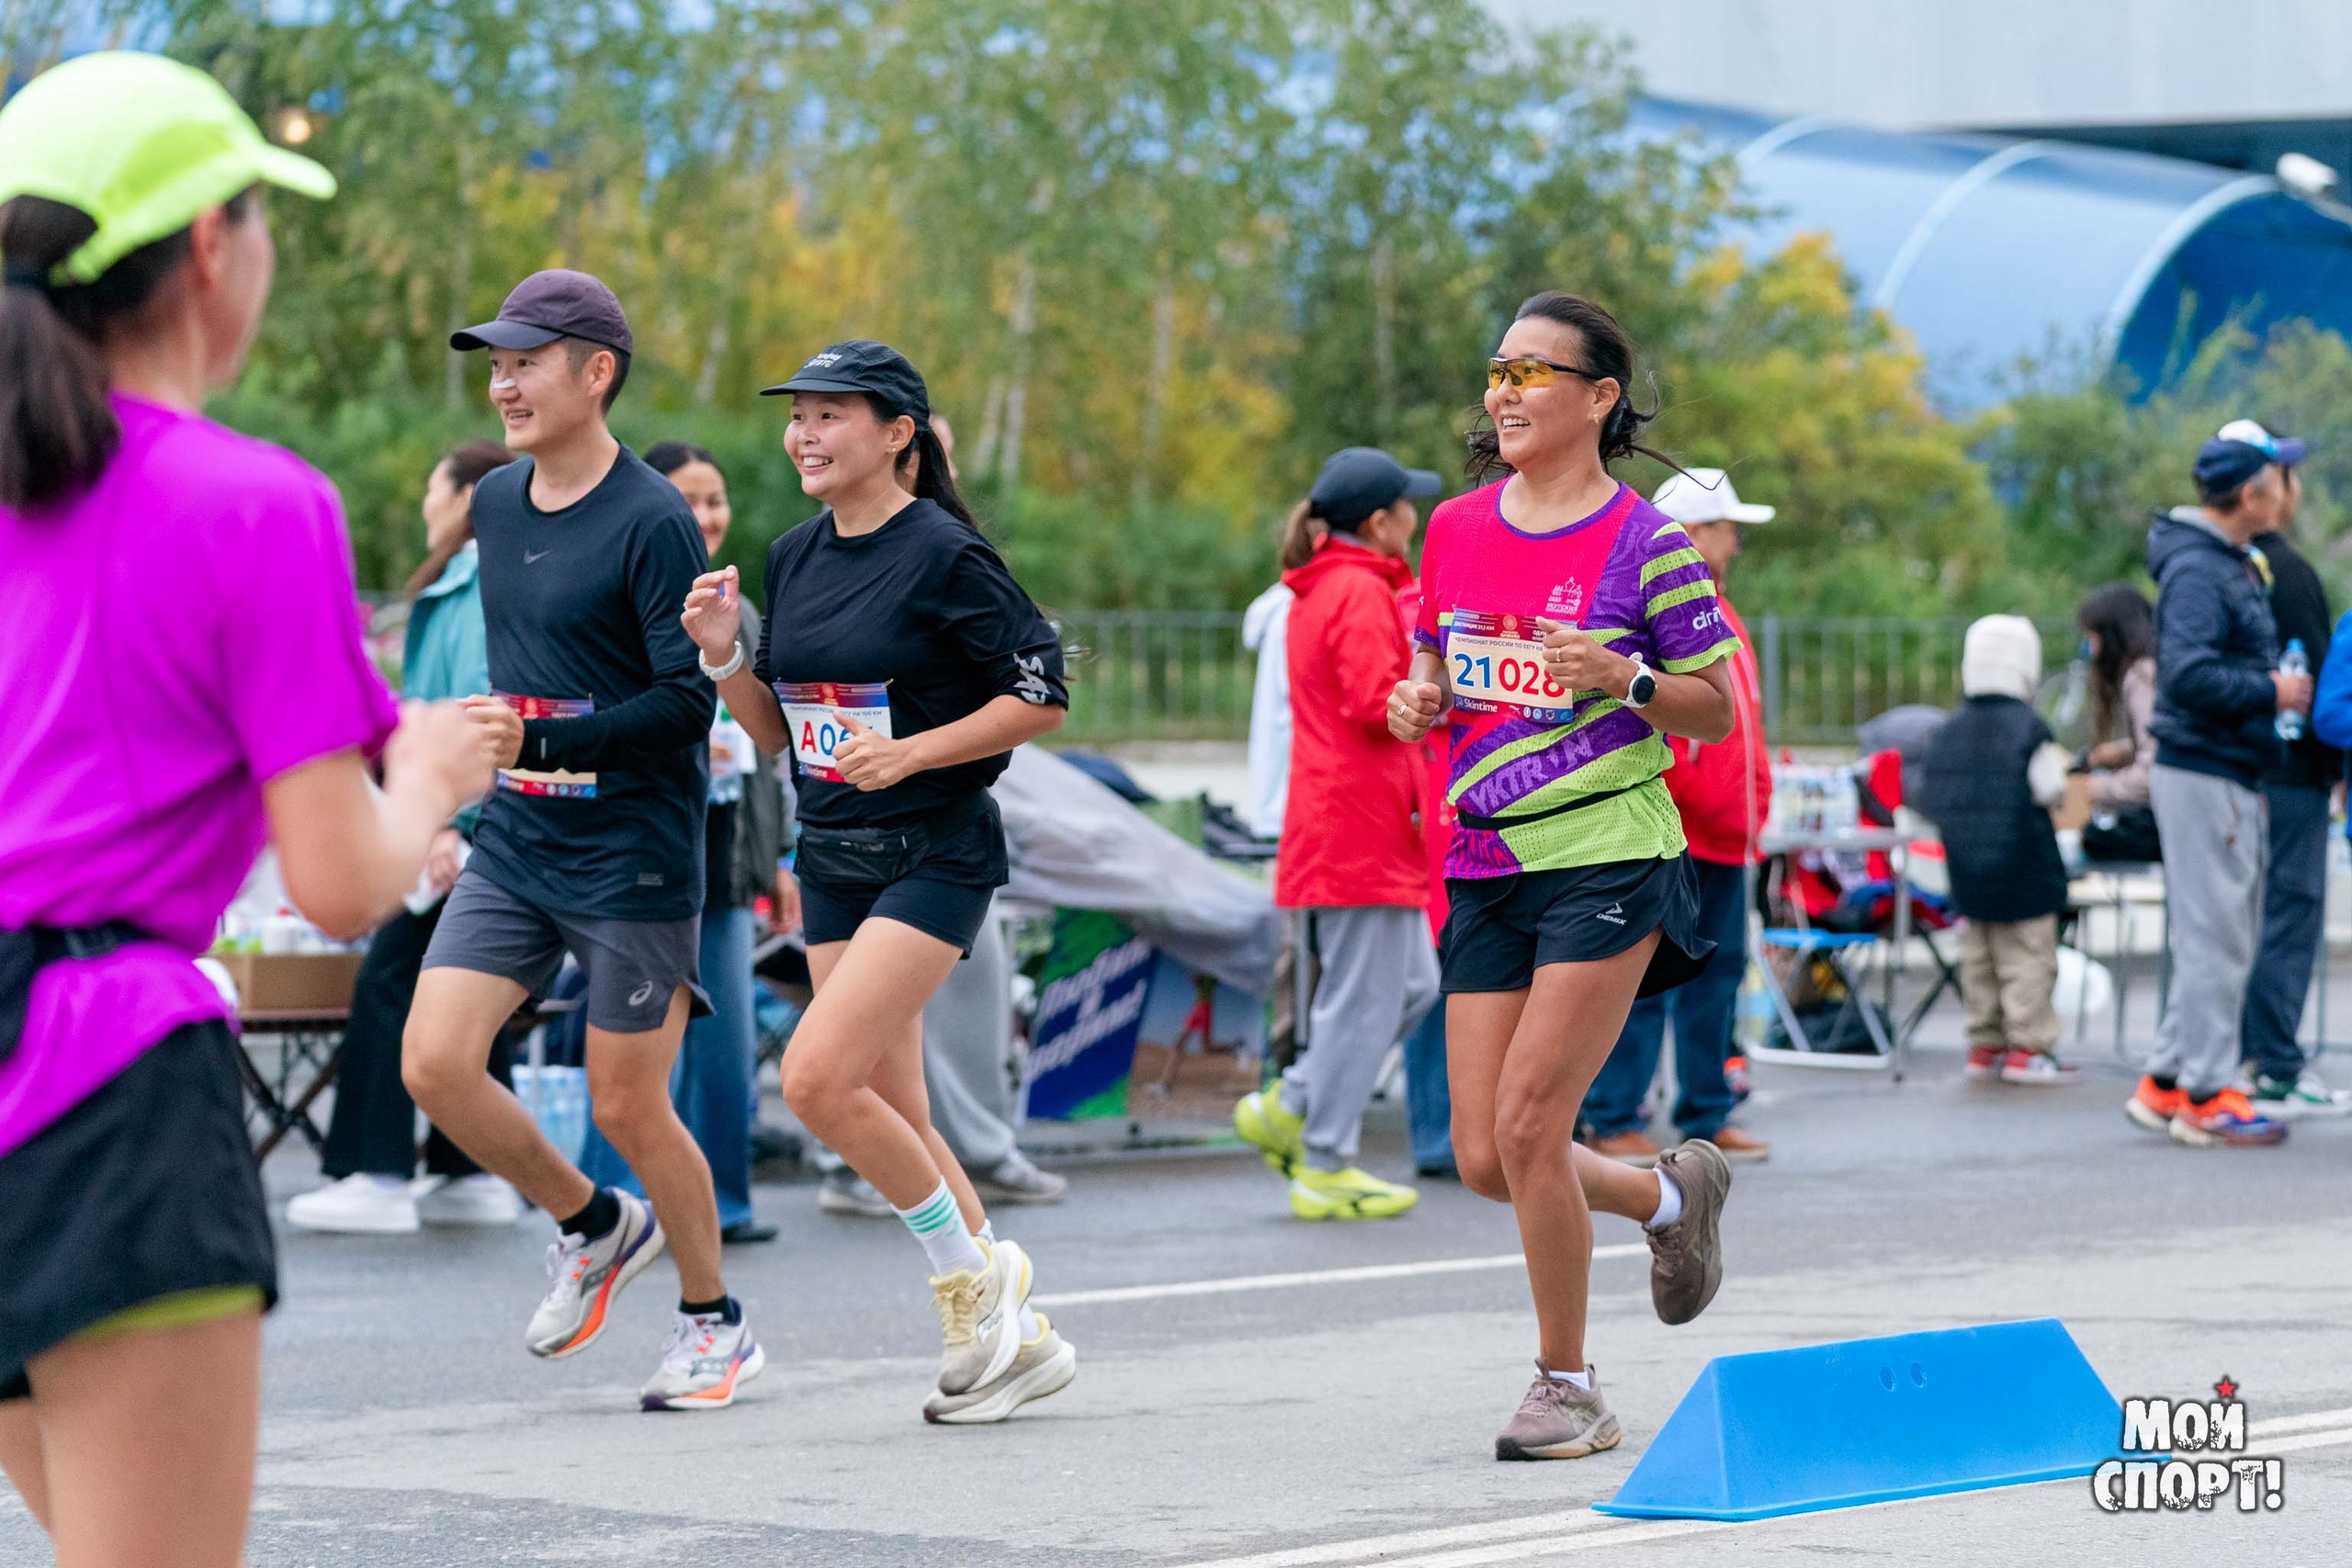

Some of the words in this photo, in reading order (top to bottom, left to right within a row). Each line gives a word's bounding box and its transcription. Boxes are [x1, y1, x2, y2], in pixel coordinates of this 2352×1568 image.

[1455, 637, 1488, 646] ЧЕМПИОНАТ
[1464, 698, 1498, 713] Skintime
[1596, 913, 1627, 926] DEMIX
